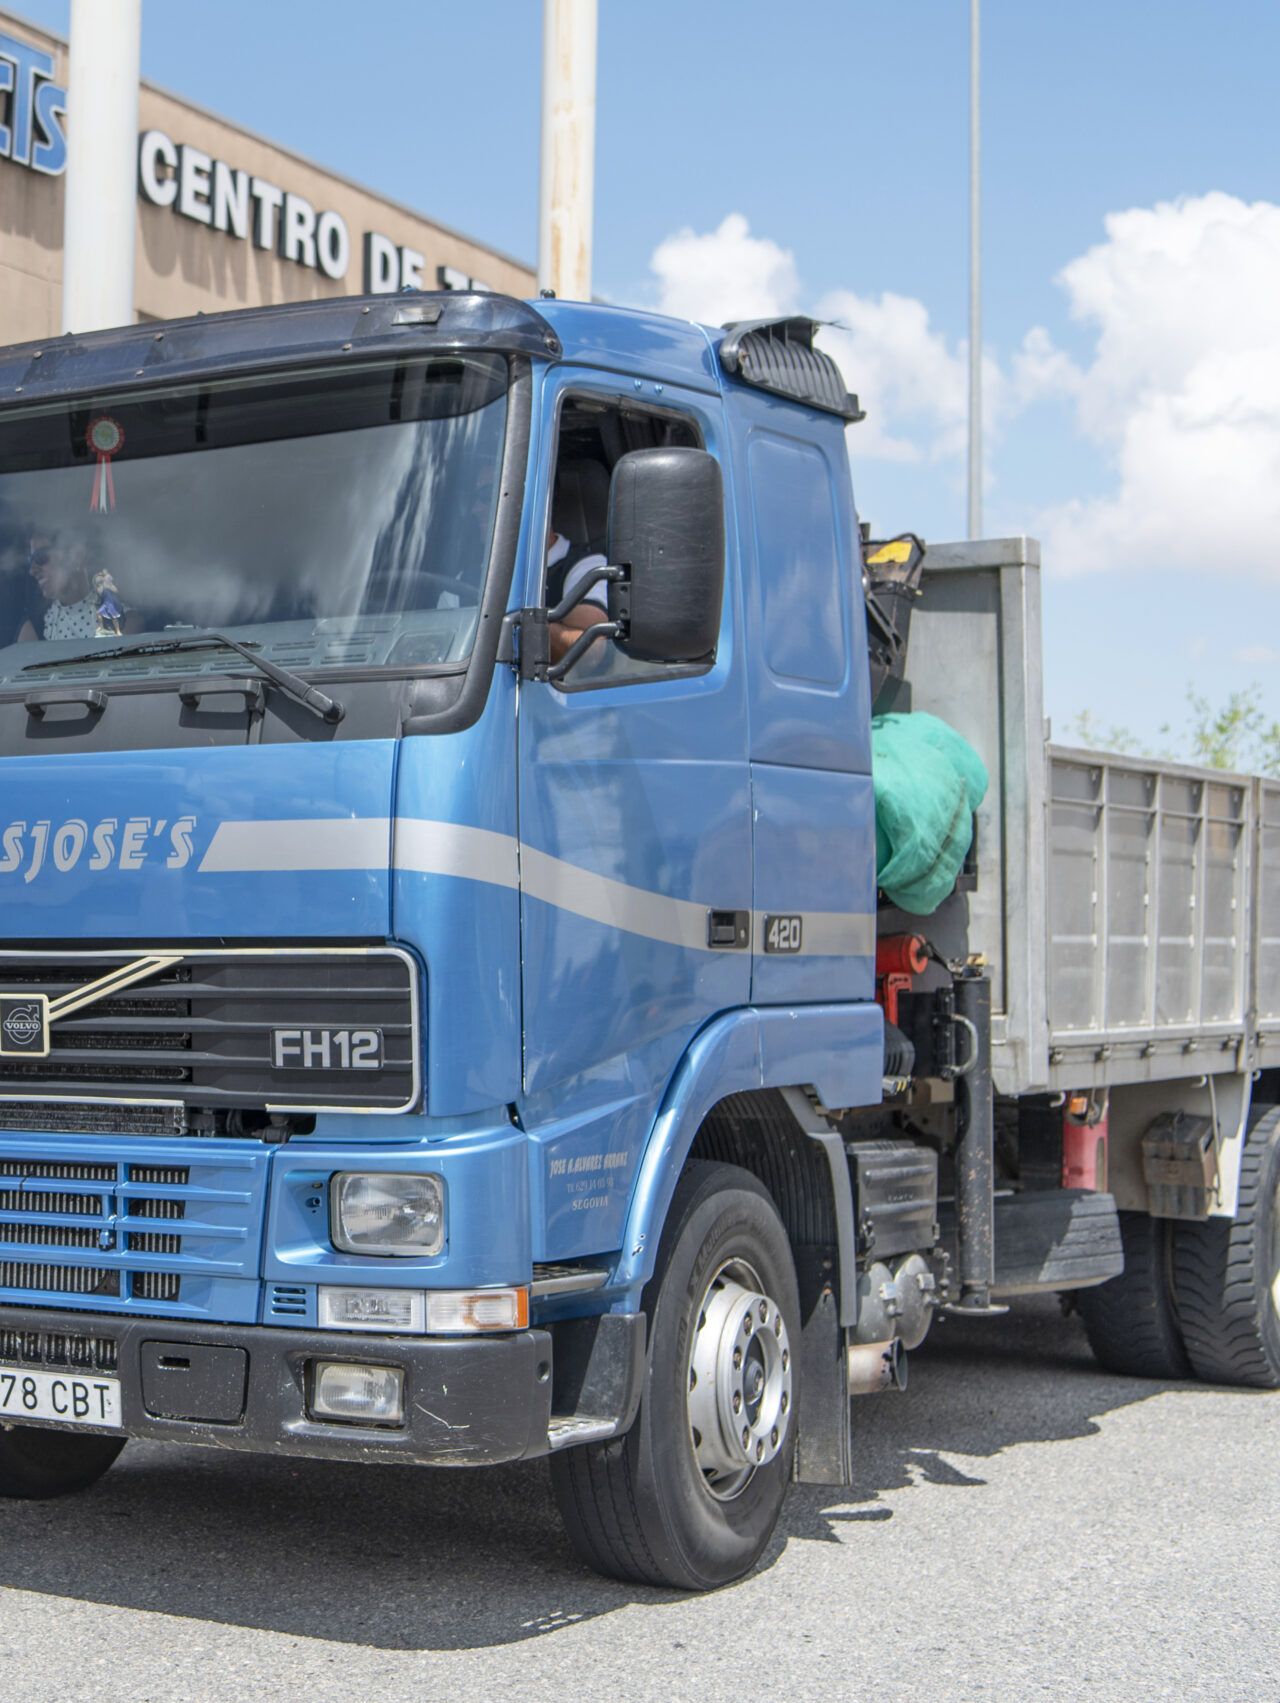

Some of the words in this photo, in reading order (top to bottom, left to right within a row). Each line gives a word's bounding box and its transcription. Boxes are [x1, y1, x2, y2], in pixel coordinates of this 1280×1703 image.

[138, 129, 350, 280] CENTRO
[365, 231, 426, 293] DE
[768, 918, 801, 949] 420
[5, 1022, 39, 1030] VOLVO
[274, 1030, 380, 1068] FH12
[572, 1195, 609, 1211] SEGOVIA
[51, 1380, 110, 1419] CBT
